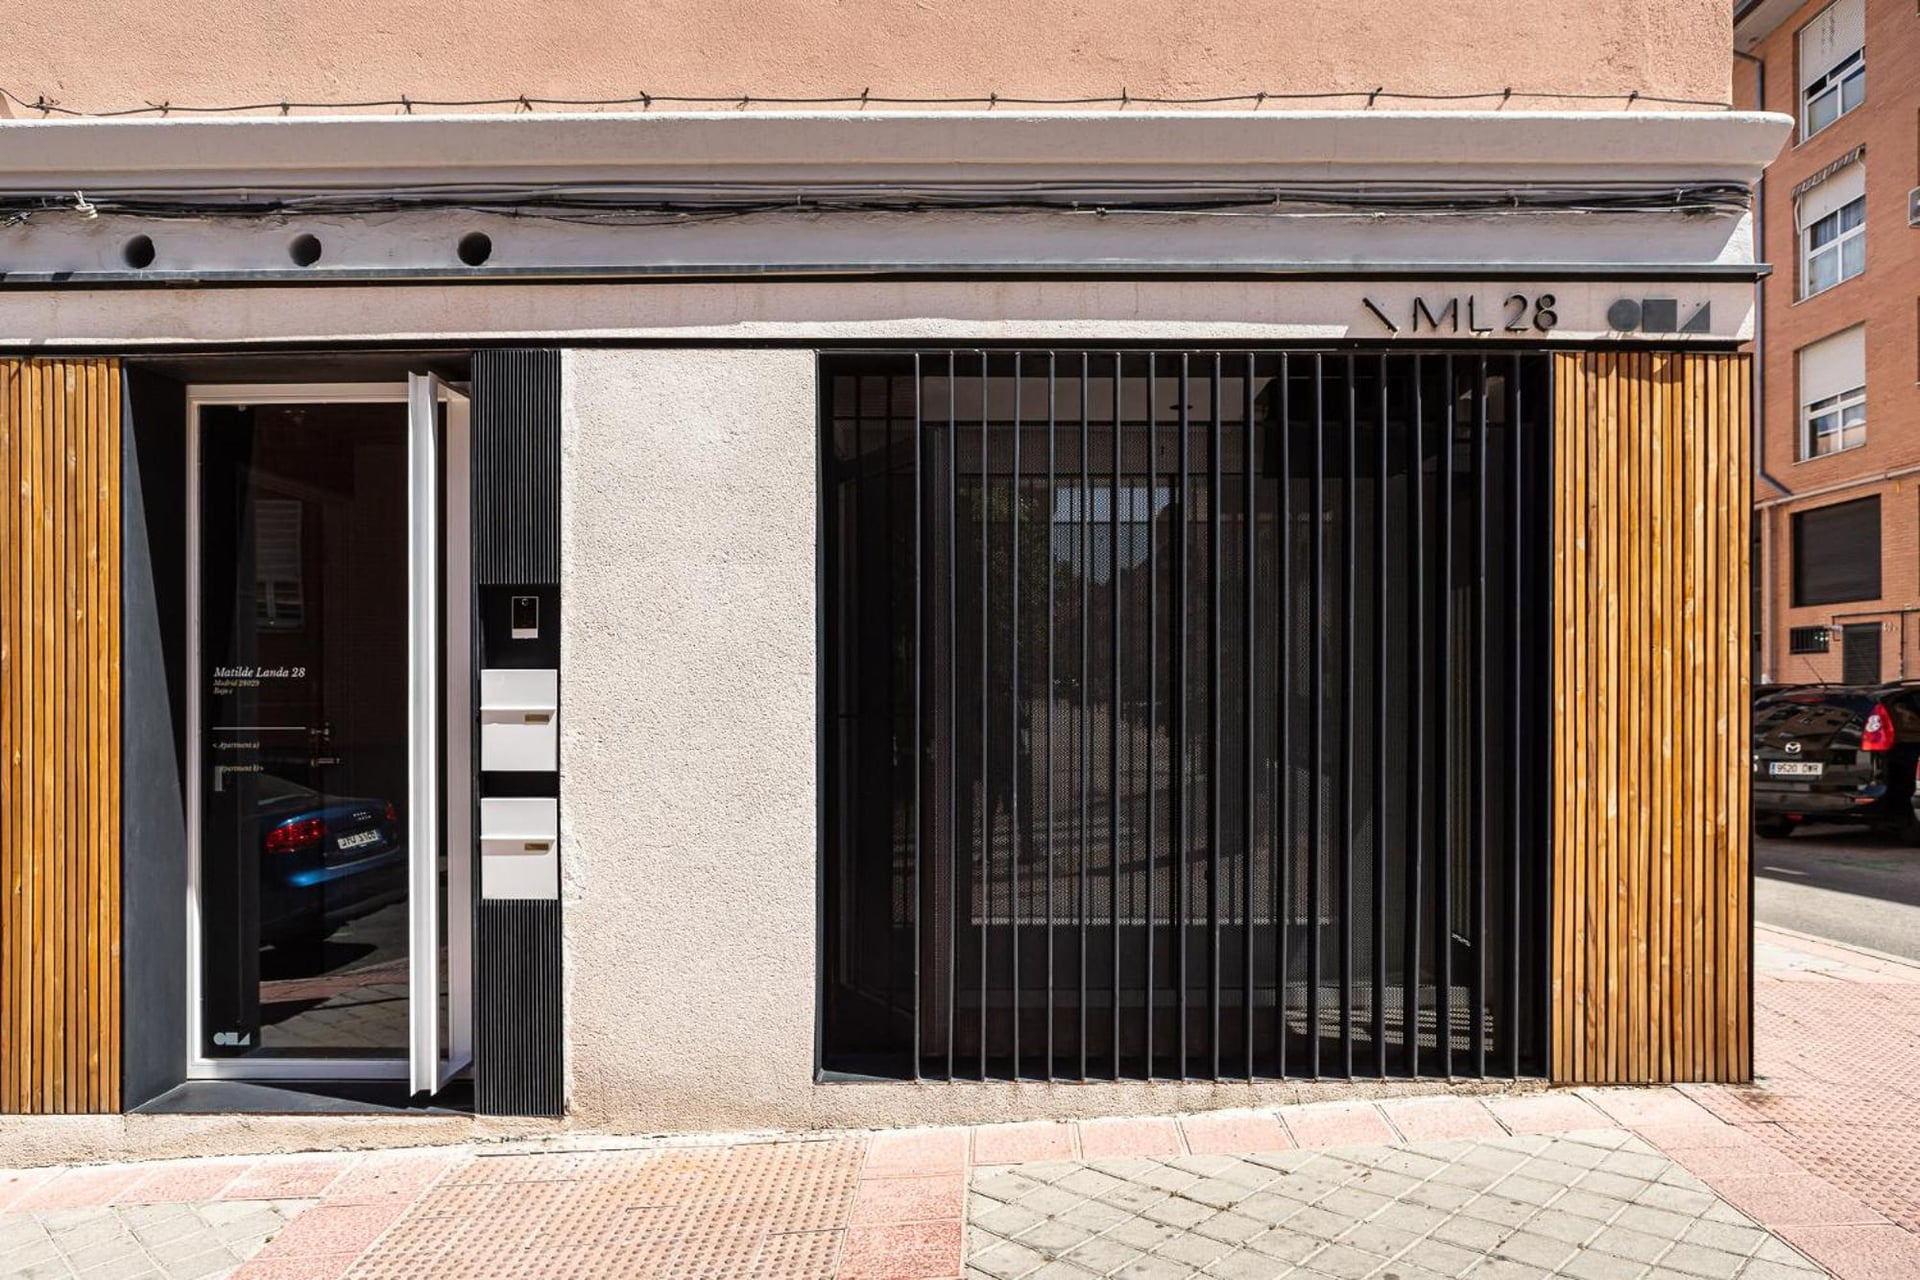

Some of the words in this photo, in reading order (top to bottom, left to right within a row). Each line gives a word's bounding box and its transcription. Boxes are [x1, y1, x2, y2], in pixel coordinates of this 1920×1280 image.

[213, 666, 254, 678] Matilde
[256, 666, 289, 678] Landa
[291, 667, 306, 678] 28
